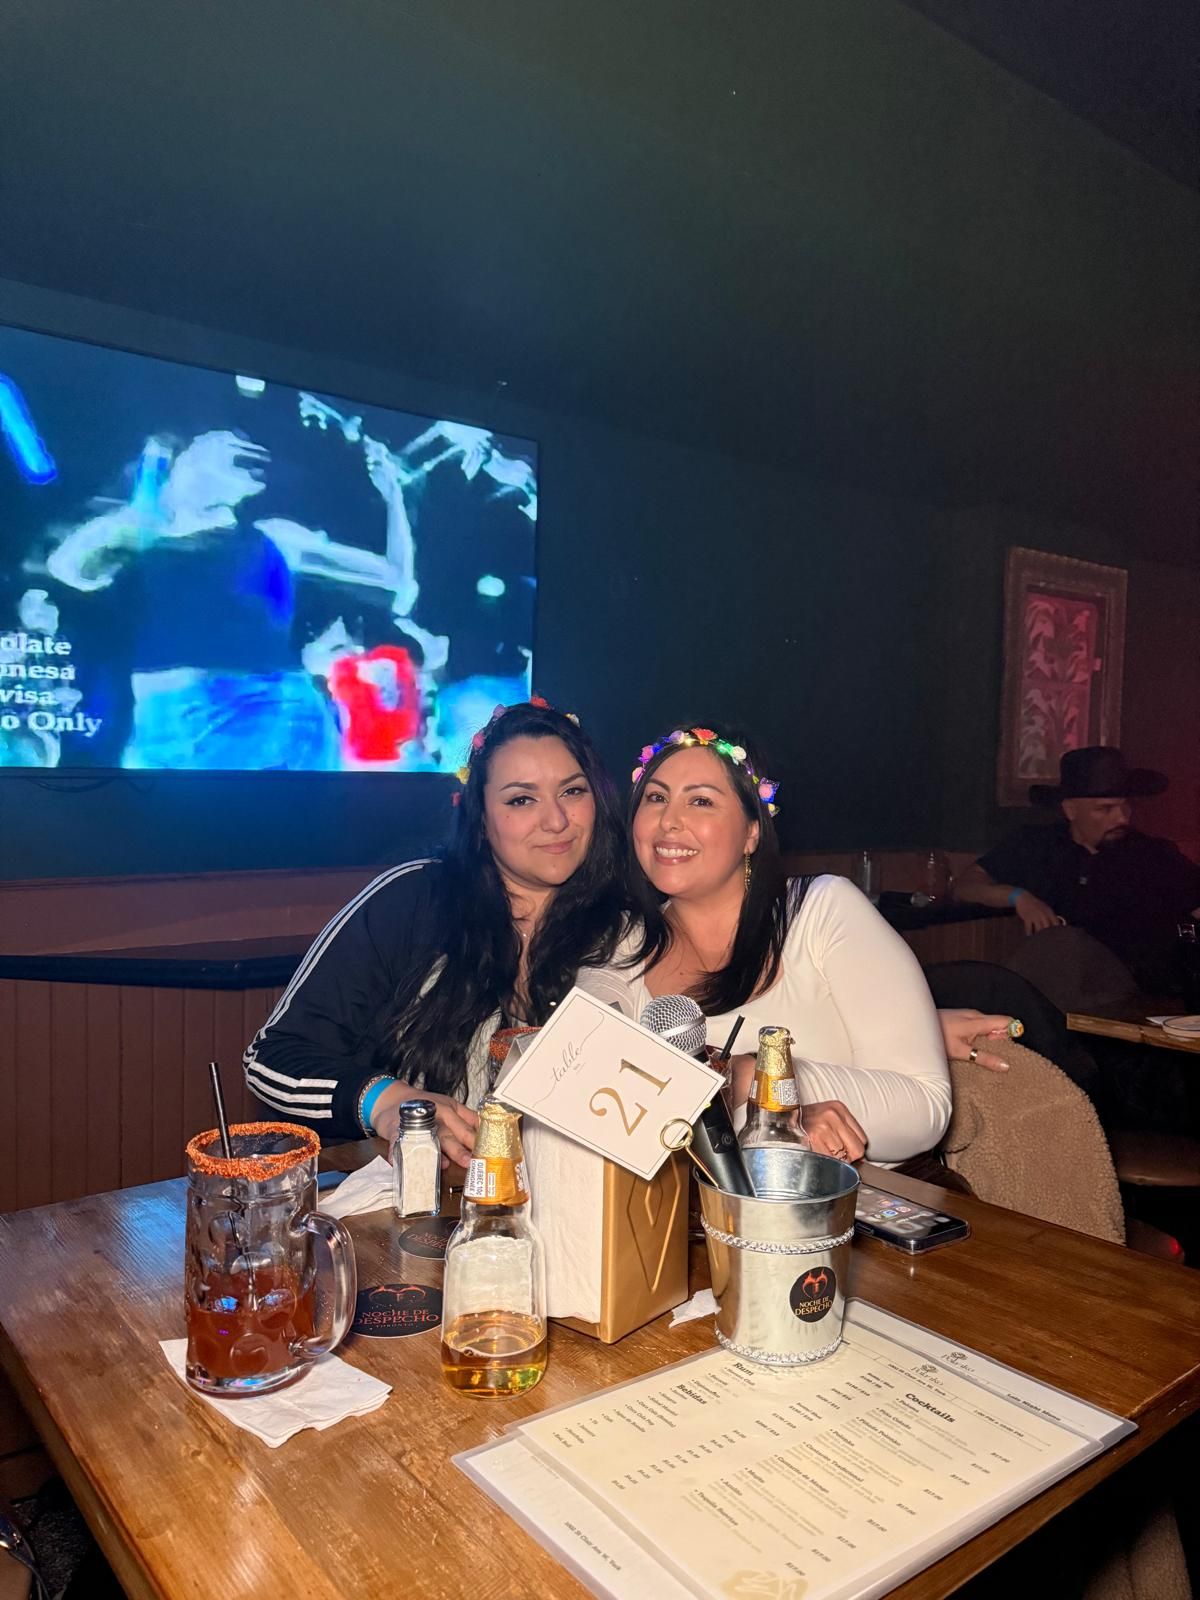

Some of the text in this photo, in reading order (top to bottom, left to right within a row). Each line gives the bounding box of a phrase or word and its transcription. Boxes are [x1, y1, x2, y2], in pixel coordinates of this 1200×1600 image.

[28, 711, 102, 737] Only
[588, 1057, 673, 1137] 21
[795, 1300, 833, 1315] DESPECHO
[799, 1300, 821, 1308] NOCHE
[362, 1309, 408, 1318] NOCHE
[733, 1362, 754, 1376] Rum
[676, 1384, 707, 1404] Bebidas
[905, 1393, 955, 1423] Cocktails
